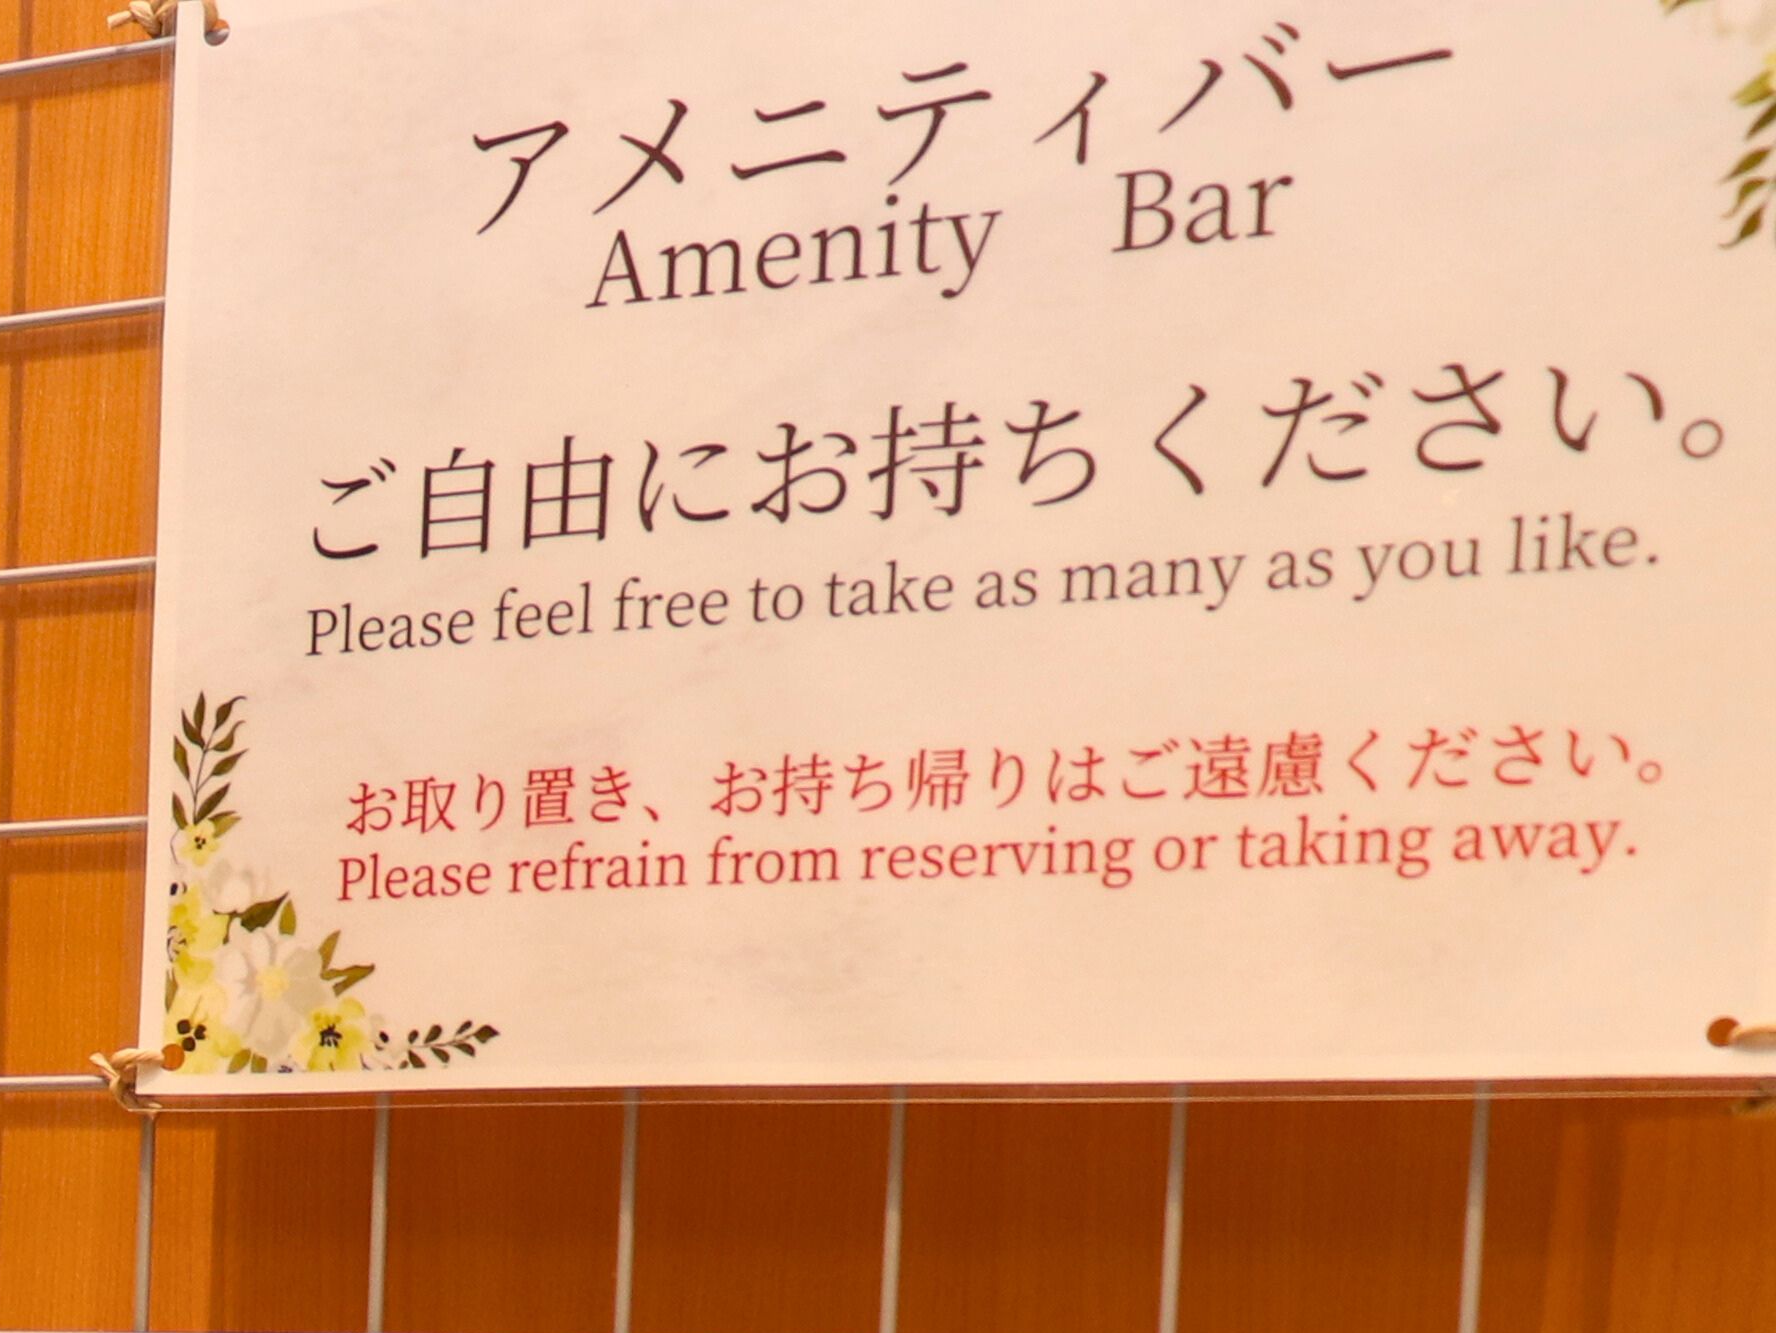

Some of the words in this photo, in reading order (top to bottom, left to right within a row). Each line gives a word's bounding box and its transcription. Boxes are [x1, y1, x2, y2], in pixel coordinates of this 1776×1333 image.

[469, 20, 1456, 237] アメニティバー
[583, 193, 1003, 311] Amenity
[1110, 166, 1295, 254] Bar
[312, 362, 1725, 561] ご自由にお持ちください。
[304, 601, 476, 657] Please
[490, 581, 594, 643] feel
[610, 576, 730, 633] free
[747, 574, 805, 623] to
[824, 558, 956, 617] take
[974, 564, 1039, 610] as
[1059, 552, 1248, 613] many
[1264, 545, 1336, 592] as
[1351, 534, 1482, 603] you
[1505, 510, 1661, 576] like.
[335, 851, 492, 902] Please
[506, 839, 688, 894] refrain
[704, 834, 842, 886] from
[859, 824, 1136, 890] reserving
[1152, 831, 1219, 873] or
[1235, 813, 1434, 879] taking
[1451, 817, 1640, 876] away.
